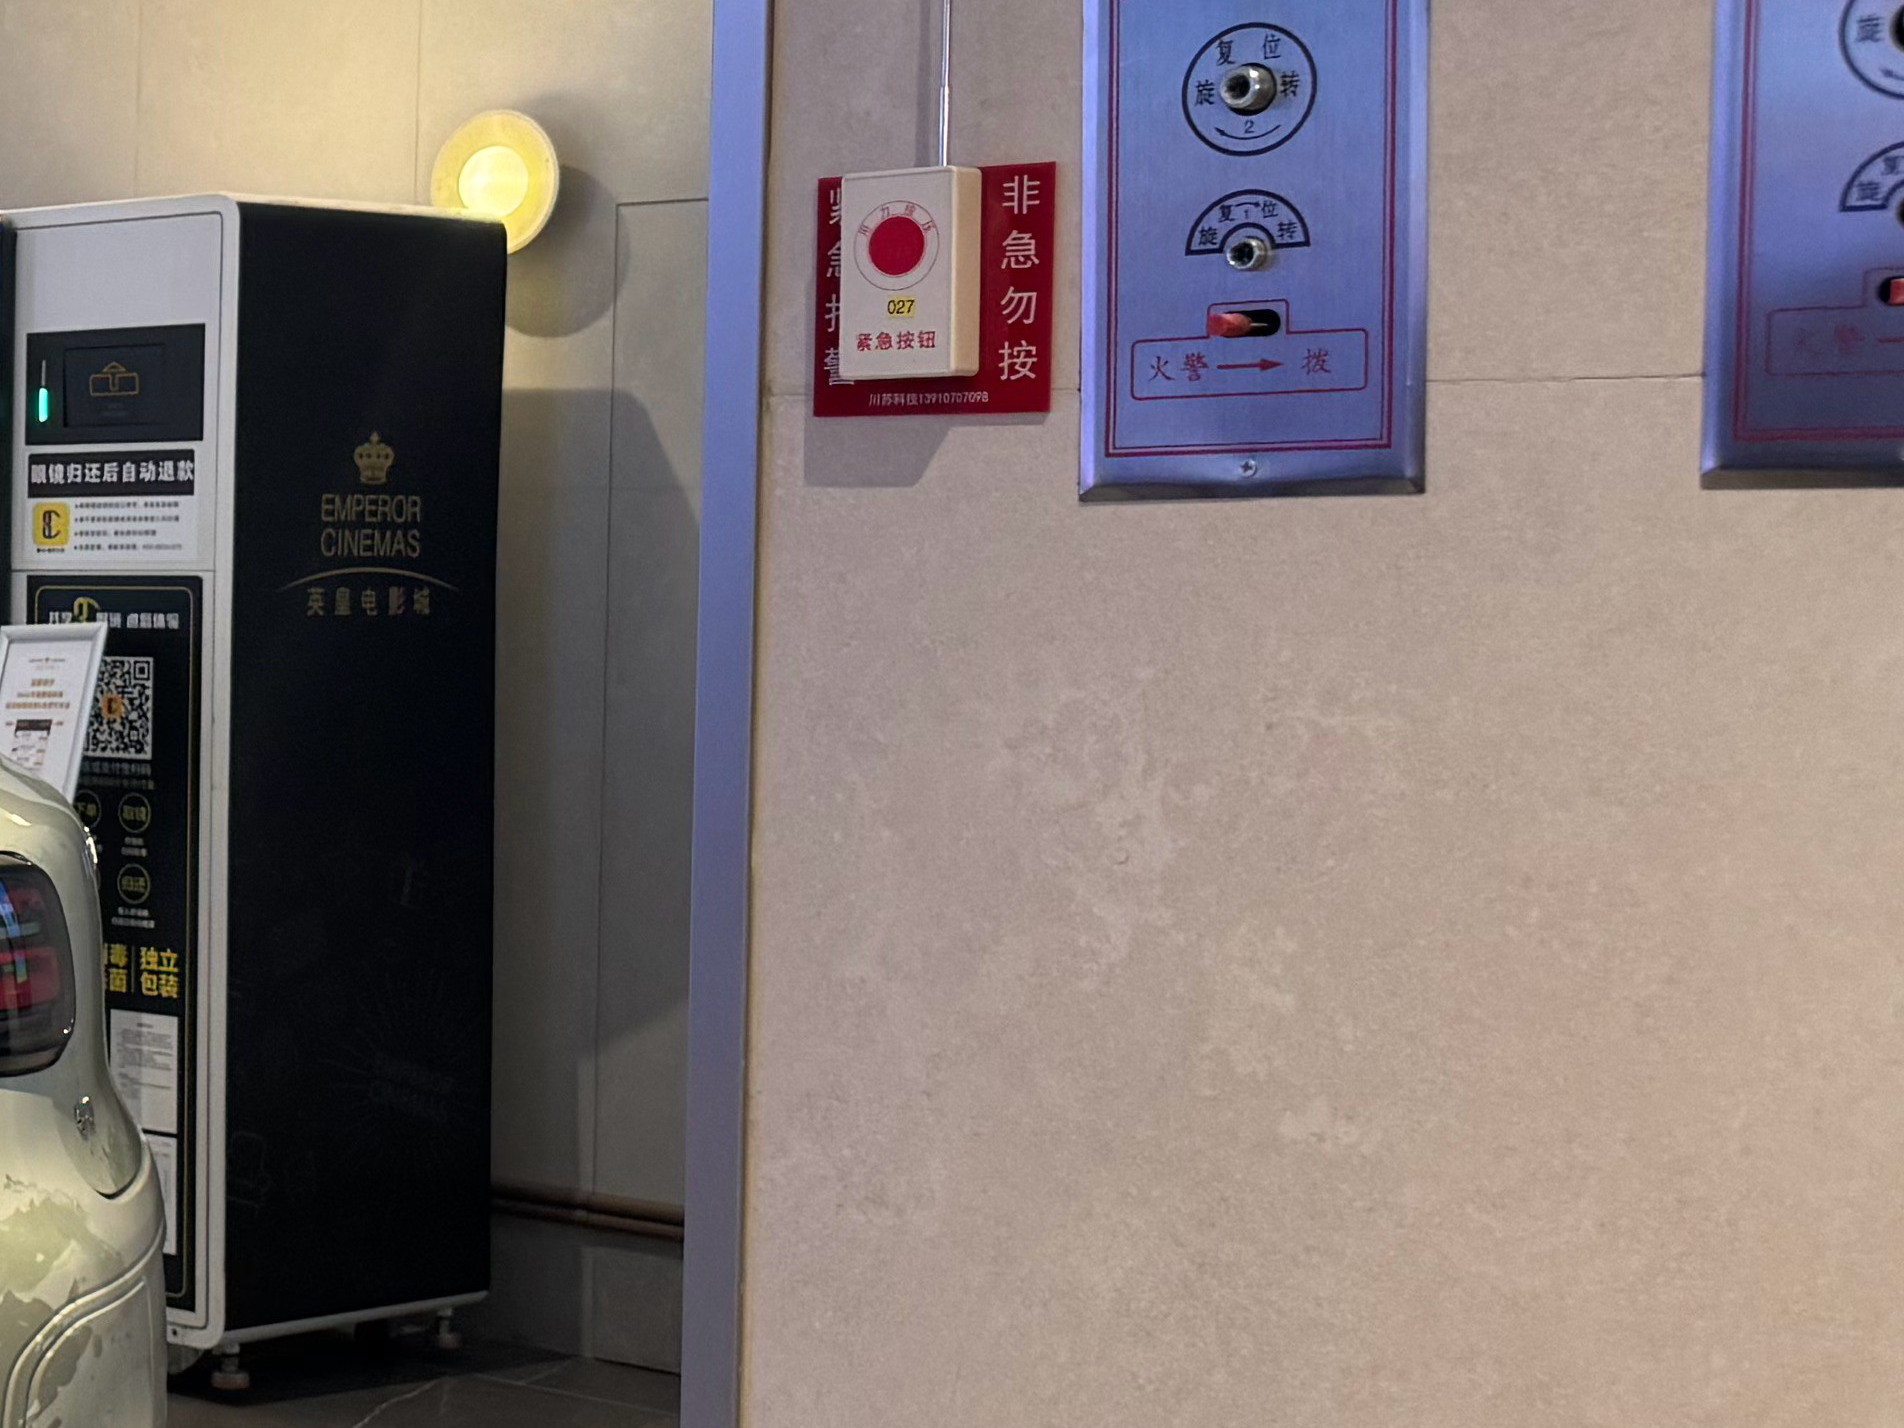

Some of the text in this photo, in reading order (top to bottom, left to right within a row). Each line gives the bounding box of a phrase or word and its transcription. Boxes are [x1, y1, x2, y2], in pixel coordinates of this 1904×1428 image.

[998, 174, 1041, 380] 非急勿按
[887, 299, 915, 315] 027
[856, 330, 936, 351] 紧急按钮
[31, 459, 195, 485] 眼镜归还后自动退款
[321, 493, 421, 523] EMPEROR
[320, 528, 421, 557] CINEMAS
[307, 586, 430, 616] 英皇电影城
[140, 946, 178, 973] 独立
[140, 974, 179, 999] 包装
